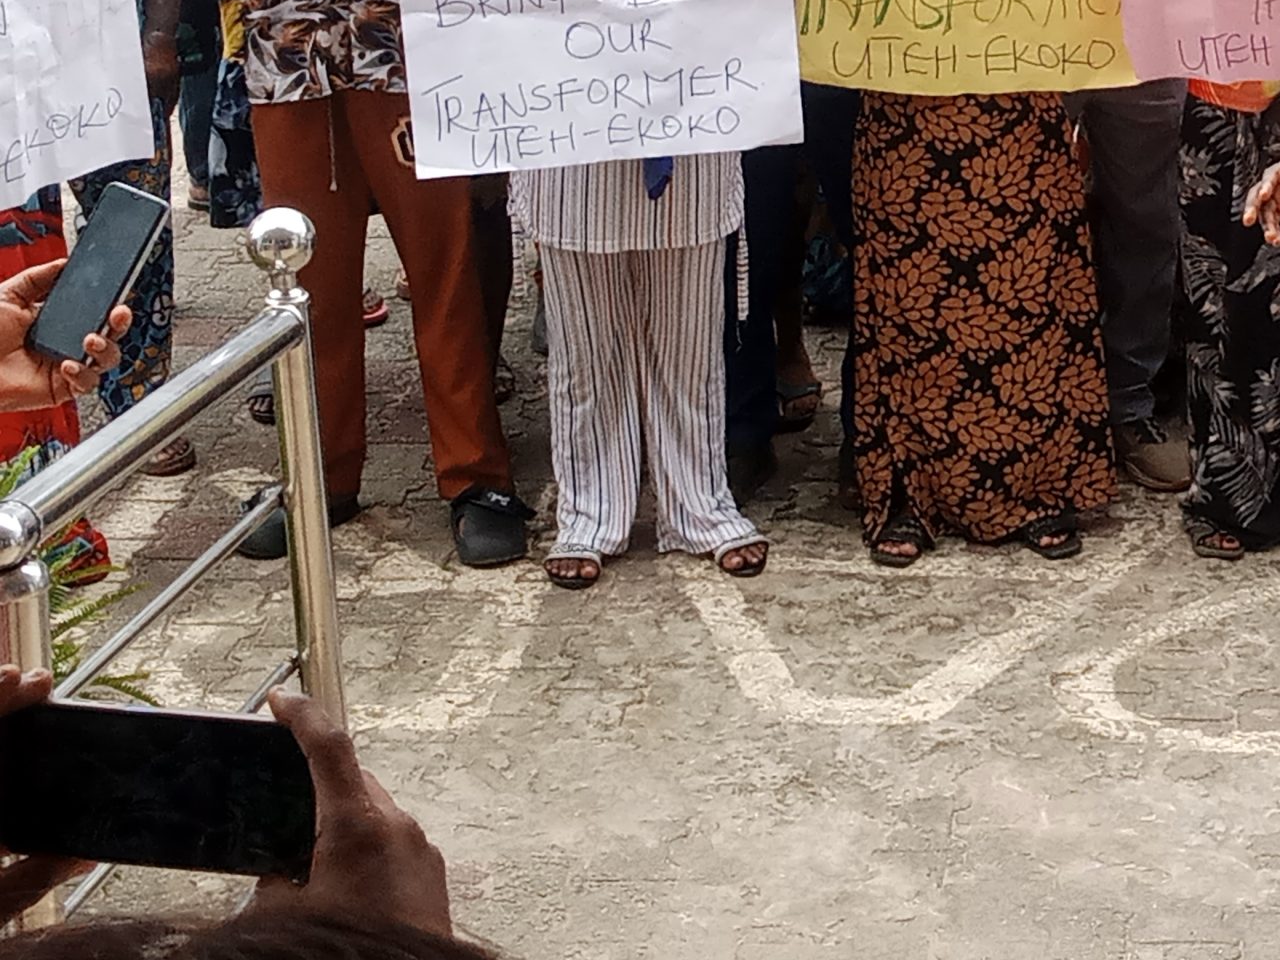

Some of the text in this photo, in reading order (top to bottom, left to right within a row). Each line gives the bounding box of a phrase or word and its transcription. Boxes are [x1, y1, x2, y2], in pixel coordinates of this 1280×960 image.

[564, 19, 672, 60] OUR
[832, 35, 1117, 80] UTEH-EKOKO
[470, 106, 741, 169] UTEH-EKOKO
